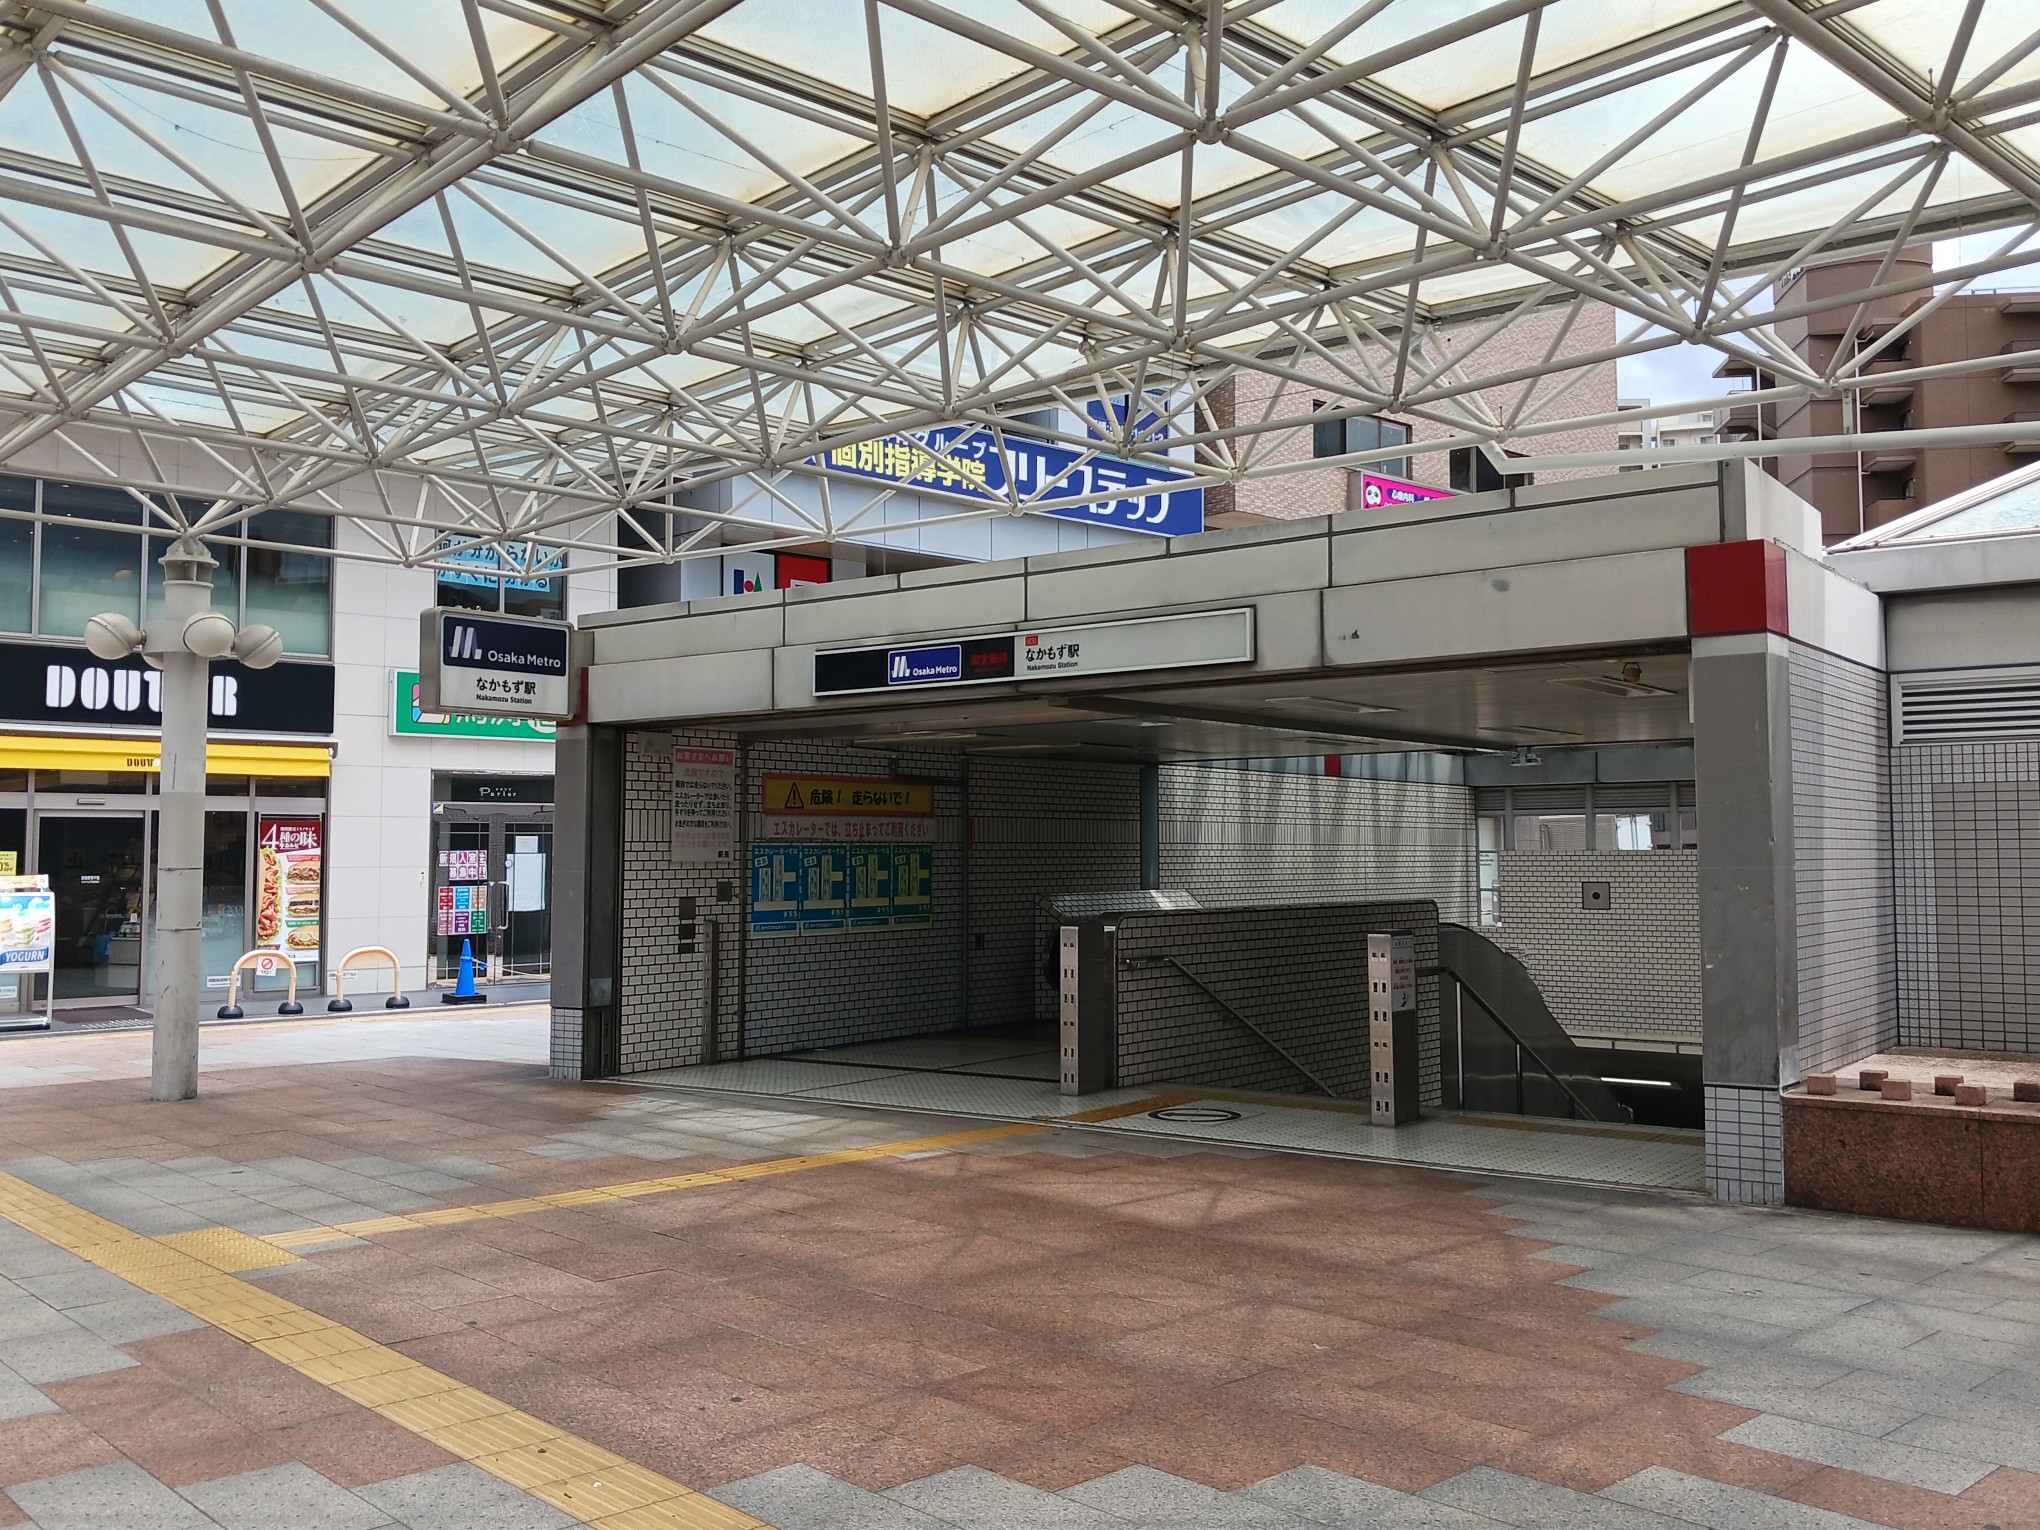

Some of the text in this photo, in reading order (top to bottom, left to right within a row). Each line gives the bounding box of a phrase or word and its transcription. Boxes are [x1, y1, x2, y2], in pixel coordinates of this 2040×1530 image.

[831, 440, 987, 492] 個別指導学院
[488, 650, 561, 668] Osaka Metro
[1026, 644, 1080, 662] なかもず駅
[912, 665, 958, 676] Osaka Metro
[1057, 661, 1079, 669] Station
[45, 665, 238, 716] DOUTR
[476, 677, 536, 695] なかもず駅
[476, 693, 533, 705] Nakamozu Station
[684, 767, 725, 778] 危険ですので
[810, 788, 910, 806] 危険！ 走らないで！
[773, 820, 929, 838] エスカレーターでは、立ち止まってご利用ください
[5, 950, 46, 962] YOGURN
